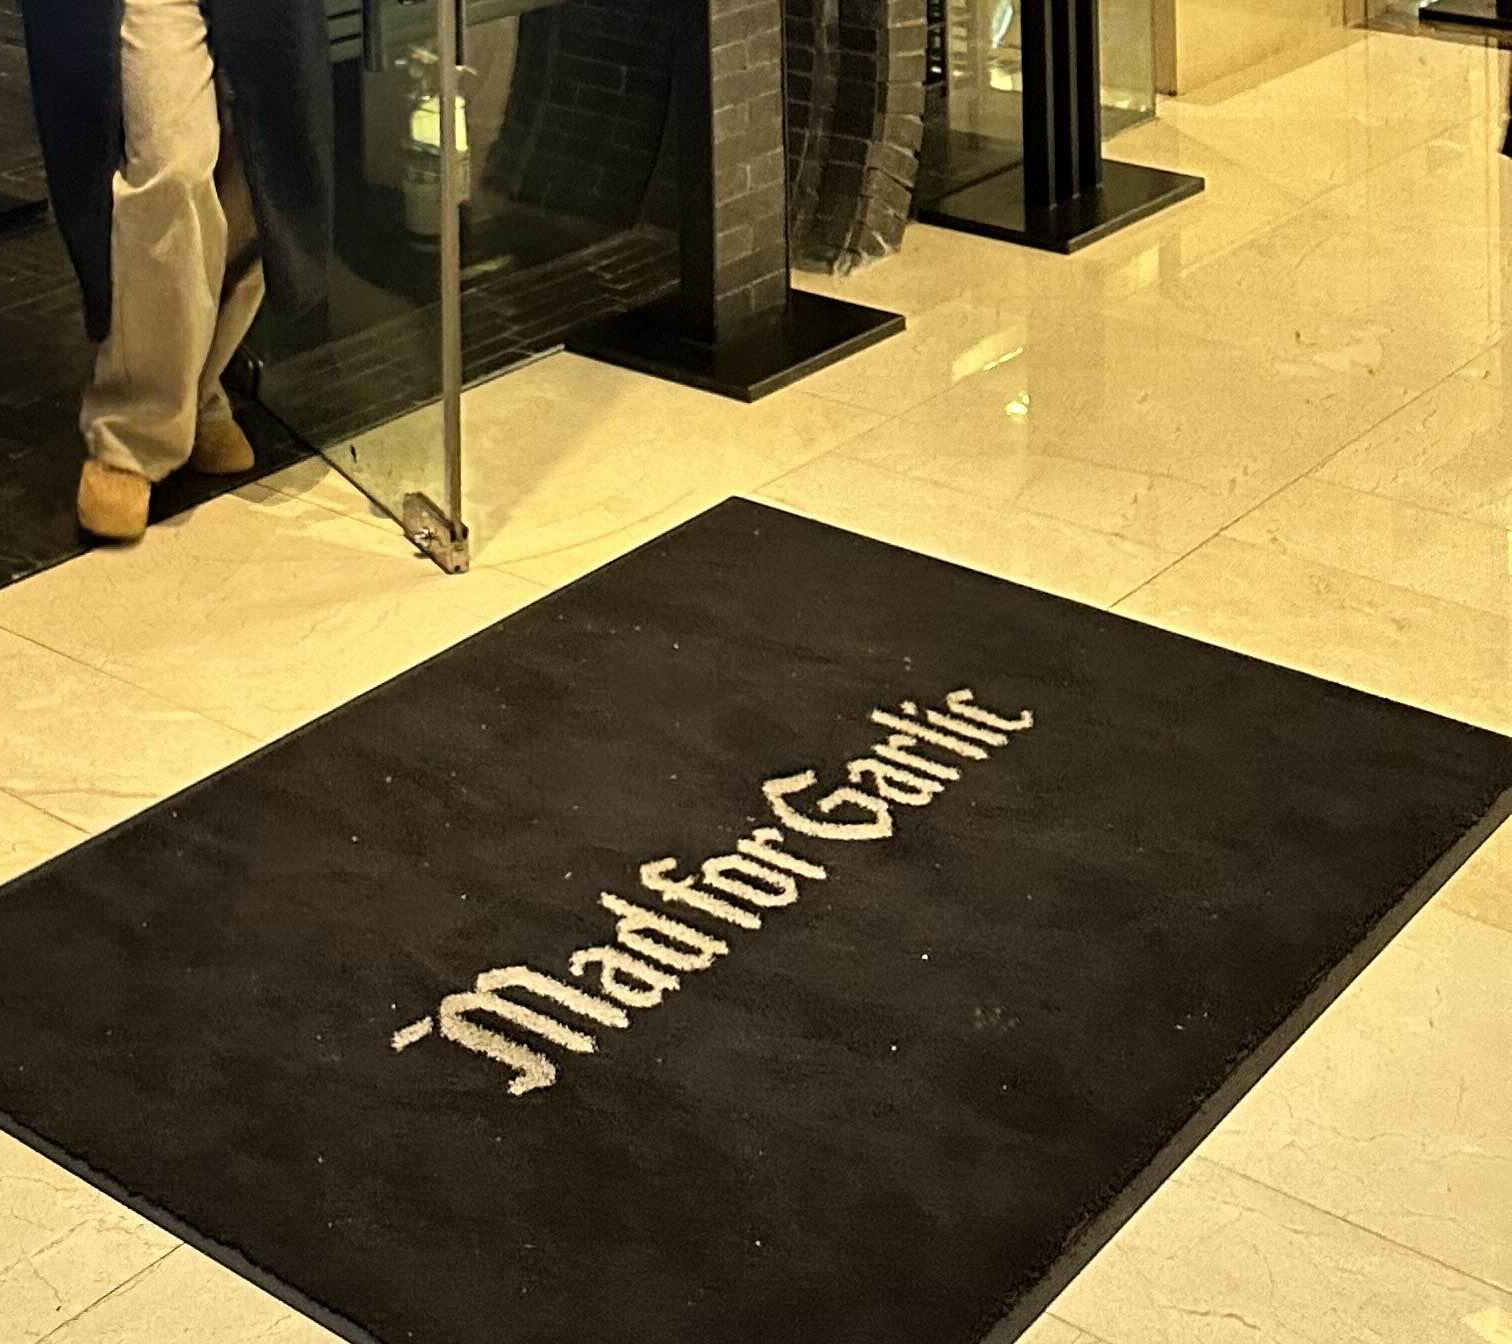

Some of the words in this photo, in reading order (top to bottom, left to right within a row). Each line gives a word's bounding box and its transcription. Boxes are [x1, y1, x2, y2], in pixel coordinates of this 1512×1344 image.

[391, 891, 730, 1096] Mad
[639, 826, 828, 930] for
[762, 688, 1034, 841] Garlic
